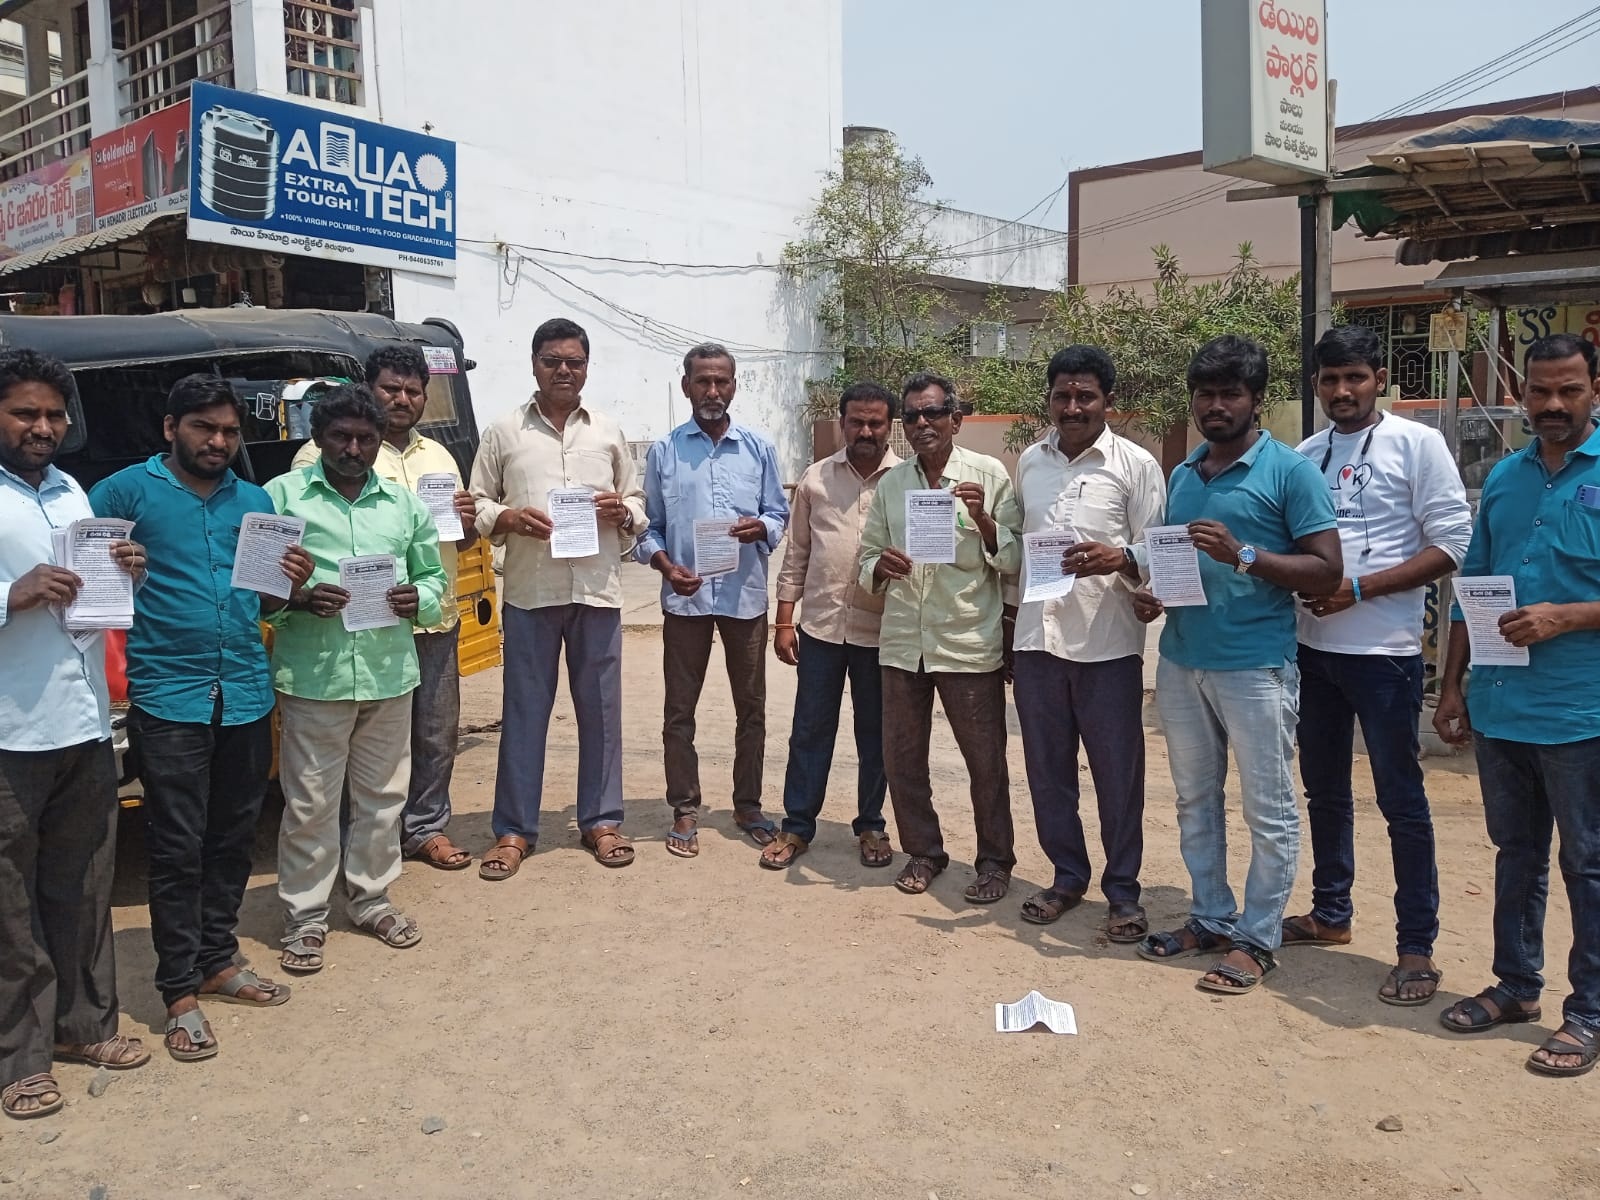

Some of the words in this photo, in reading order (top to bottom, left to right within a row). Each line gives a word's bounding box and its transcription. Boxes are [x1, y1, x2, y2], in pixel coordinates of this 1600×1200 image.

[281, 121, 418, 190] AQUA
[284, 171, 349, 195] EXTRA
[284, 187, 359, 213] TOUGH!
[357, 181, 453, 233] TECH
[304, 217, 328, 228] VIRGIN
[329, 220, 361, 232] POLYMER
[383, 229, 401, 239] FOOD
